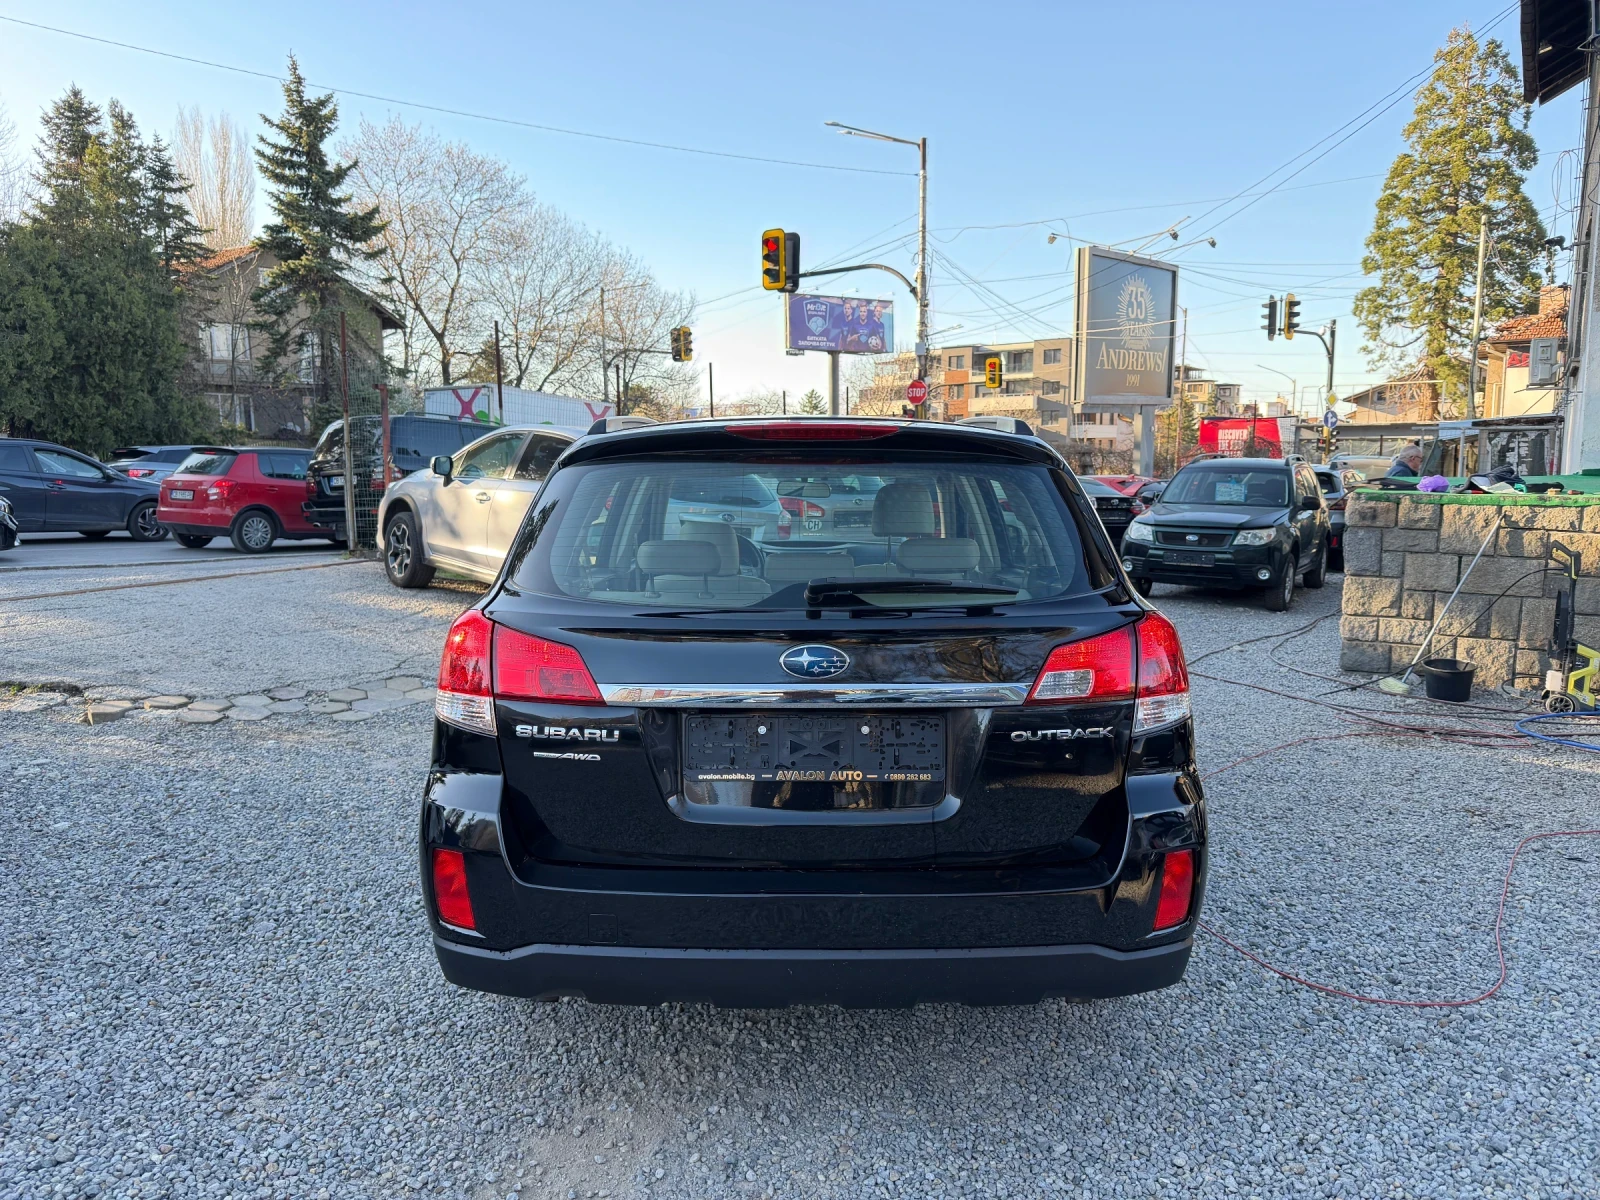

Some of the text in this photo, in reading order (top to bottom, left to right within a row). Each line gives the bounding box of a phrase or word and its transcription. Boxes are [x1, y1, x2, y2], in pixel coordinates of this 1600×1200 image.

[1128, 287, 1146, 319] 35
[1126, 374, 1140, 387] 1991
[908, 388, 925, 397] STOP
[1218, 429, 1248, 439] DISCOVER
[807, 520, 820, 530] CH
[515, 724, 620, 742] SUBARU
[1010, 726, 1114, 742] OUTBACK
[558, 752, 601, 761] AWD
[698, 773, 756, 781] avalon.mobile.bg
[776, 770, 825, 780] AVALON
[829, 770, 863, 780] AUTO
